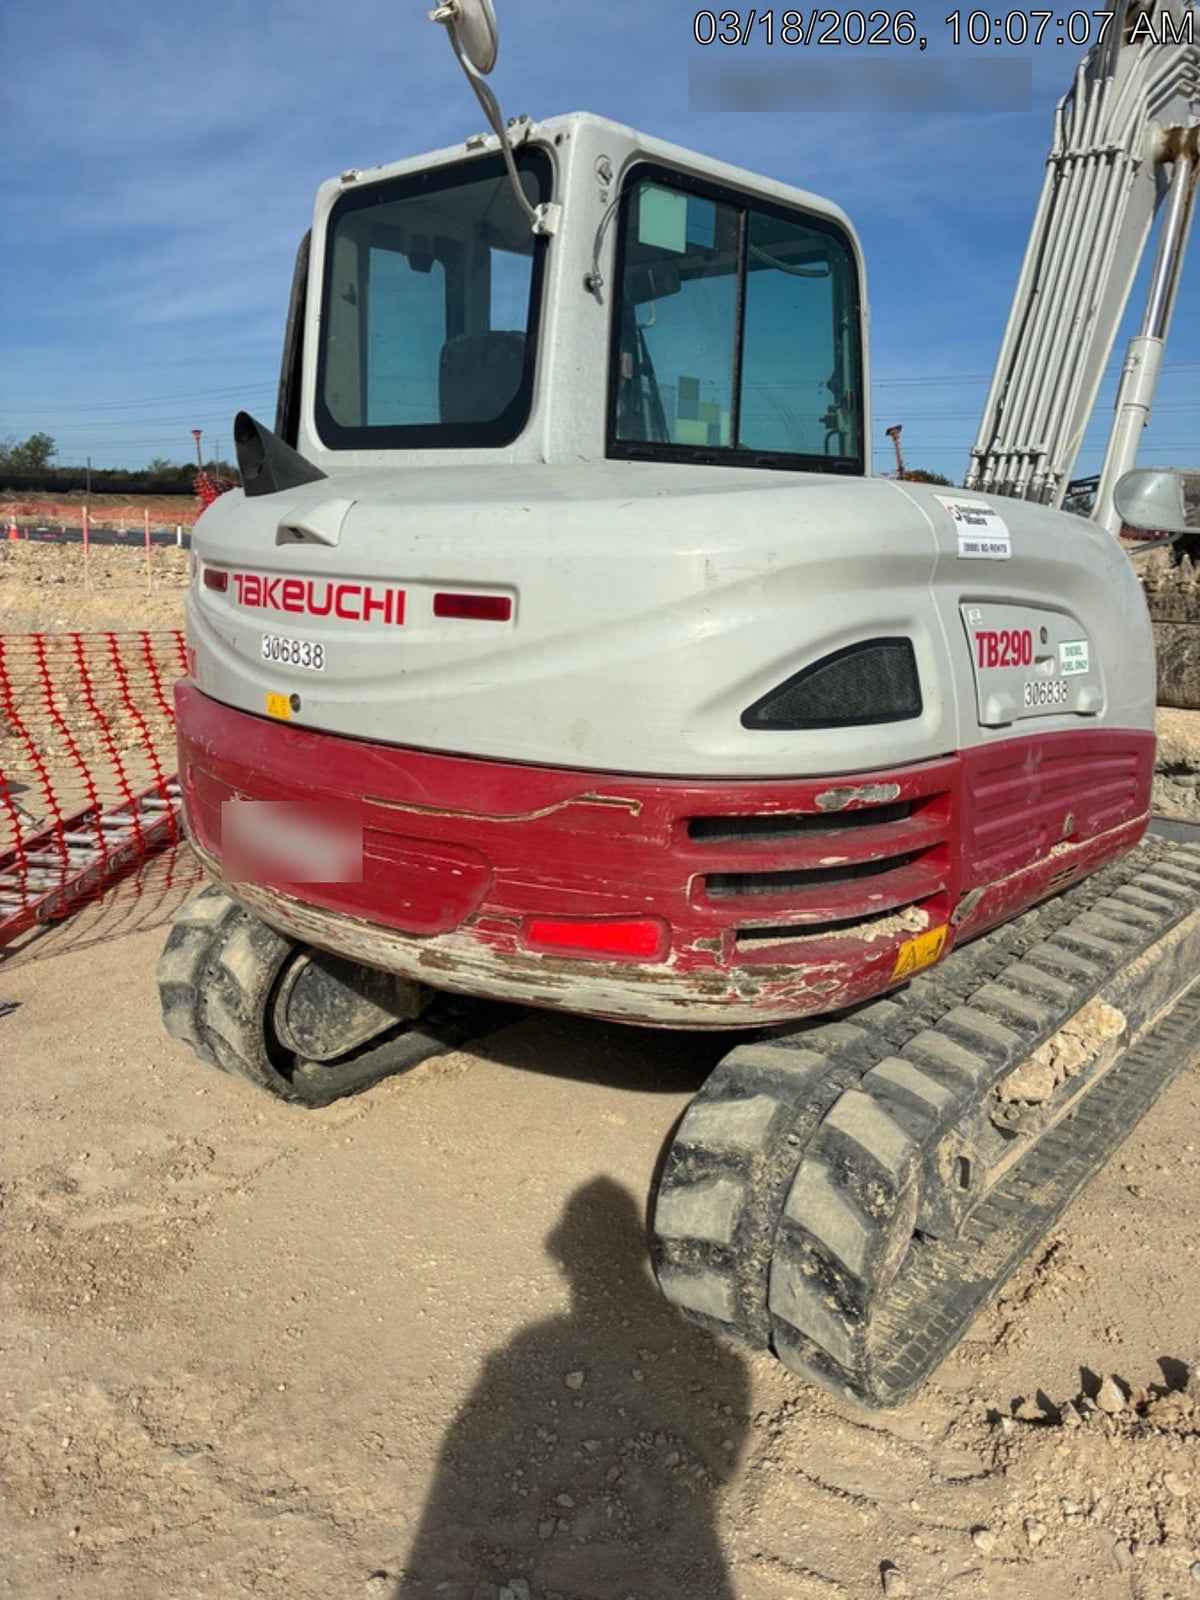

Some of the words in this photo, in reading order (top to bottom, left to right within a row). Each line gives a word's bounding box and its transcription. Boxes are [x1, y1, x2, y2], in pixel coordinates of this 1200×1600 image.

[262, 634, 323, 670] 306838
[974, 629, 1033, 668] TB290
[1025, 680, 1069, 705] 306838
